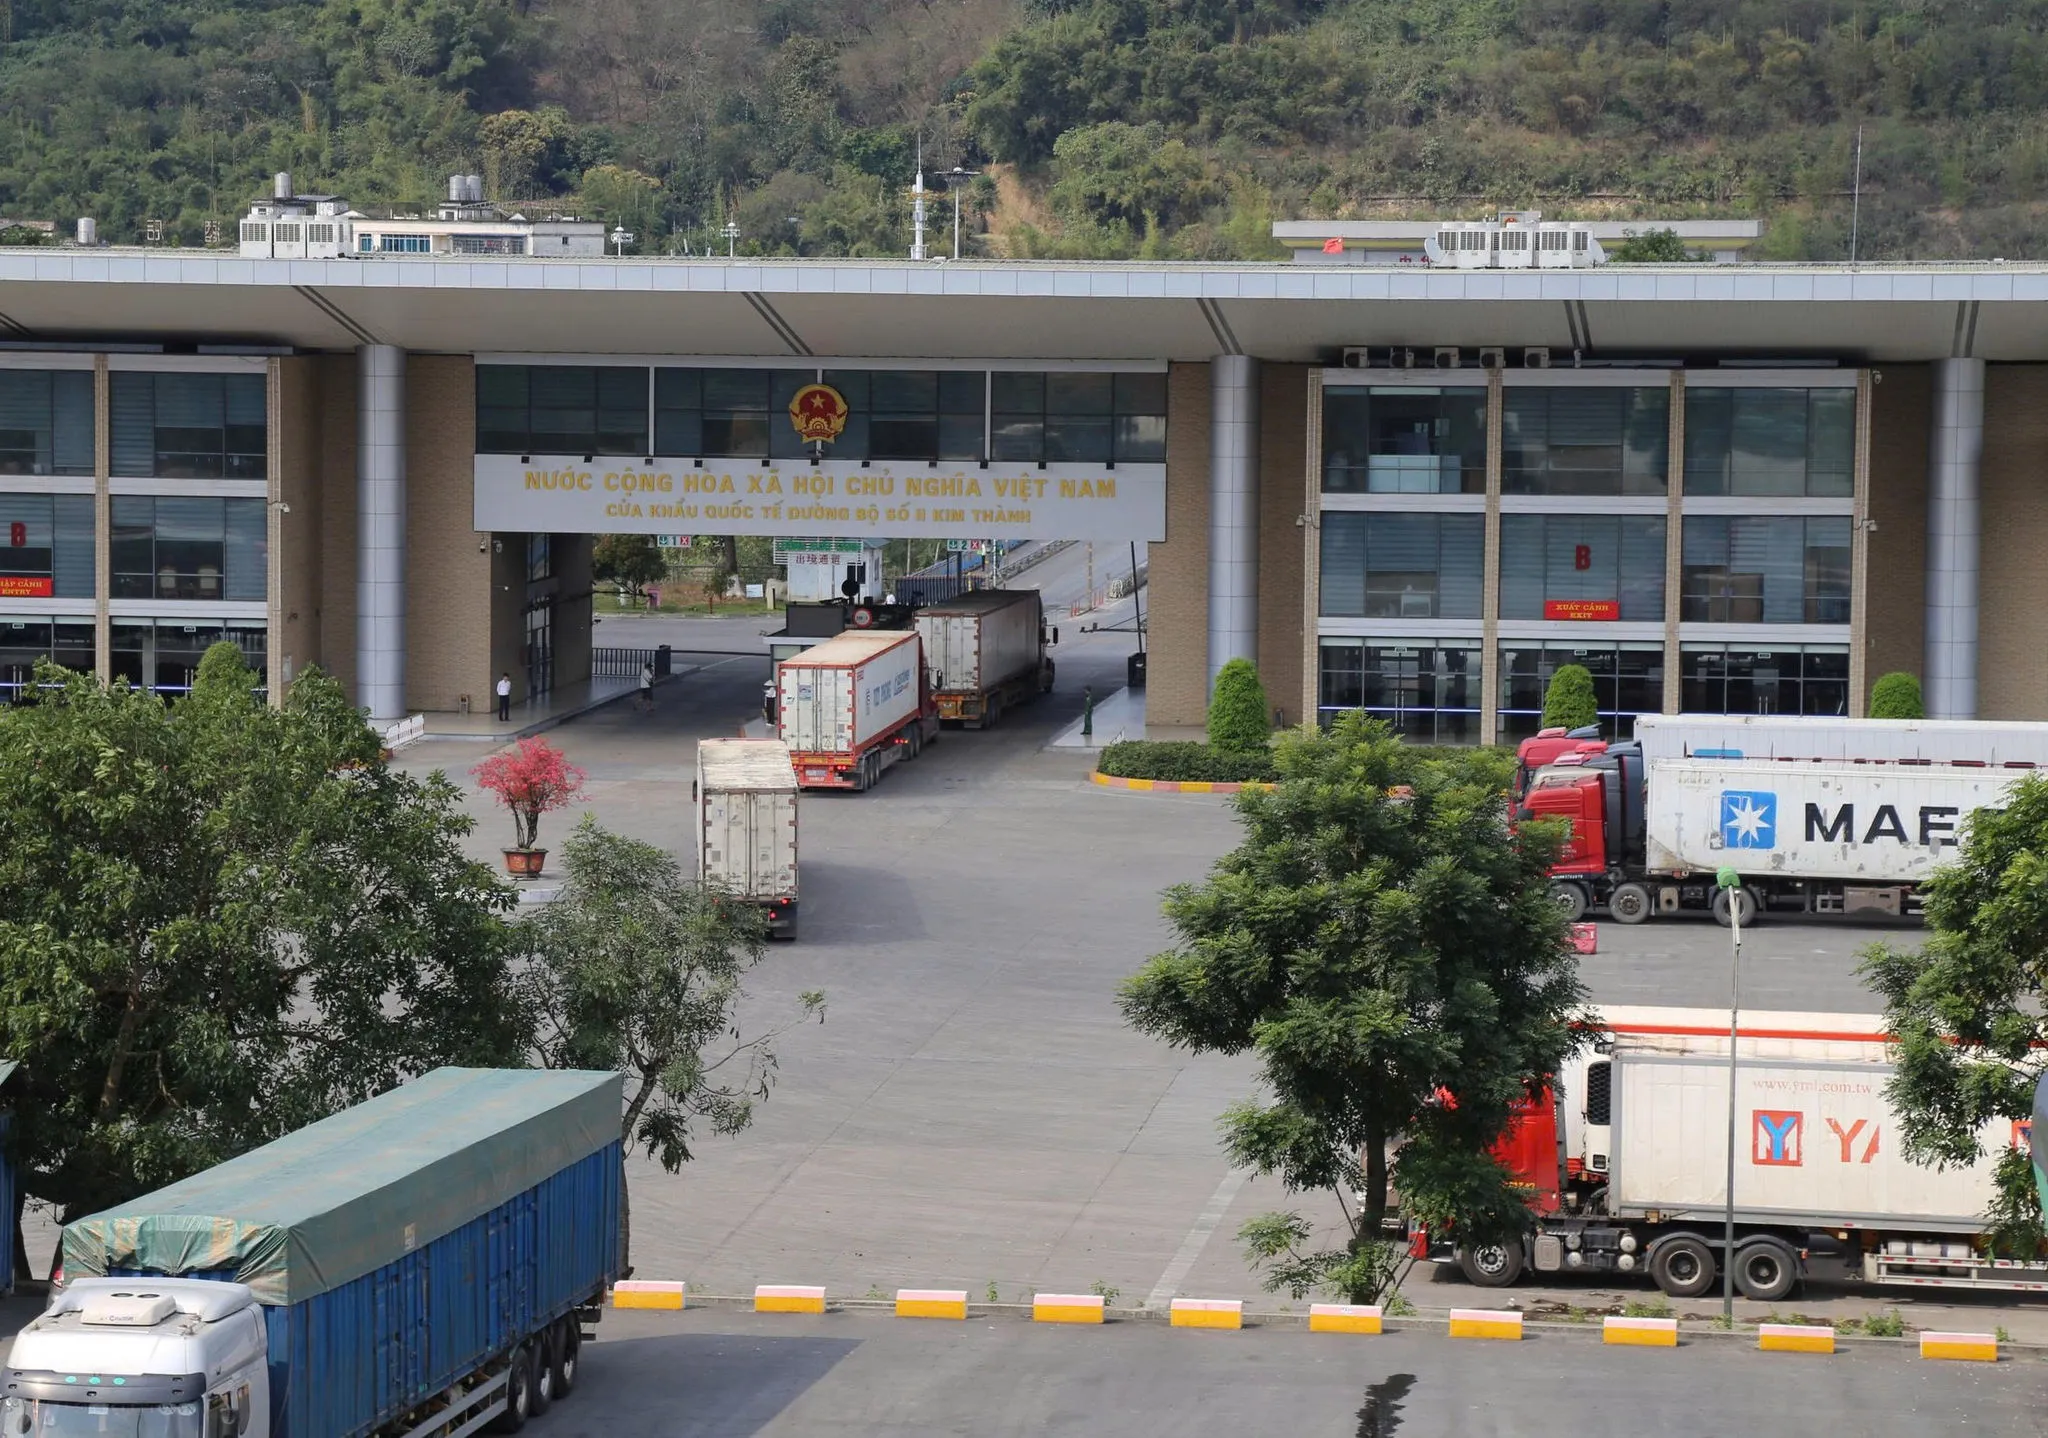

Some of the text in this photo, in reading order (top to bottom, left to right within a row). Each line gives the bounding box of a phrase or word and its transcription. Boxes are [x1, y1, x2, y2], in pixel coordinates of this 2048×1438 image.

[524, 466, 1116, 502] NƯỚC CỘNG HÒA XÃ HỘI CHỦ NGHĨA VIỆT NAM
[606, 499, 643, 518] CỬA
[649, 498, 698, 518] KHẨU
[705, 500, 754, 519] QUỐC
[761, 500, 784, 519] TẾ
[787, 502, 850, 520] ĐƯỜNG
[856, 504, 879, 525] BỘ
[886, 502, 910, 520] SỐ
[933, 509, 965, 521] KIM
[972, 505, 1031, 523] THÀNH
[1575, 545, 1591, 571] B
